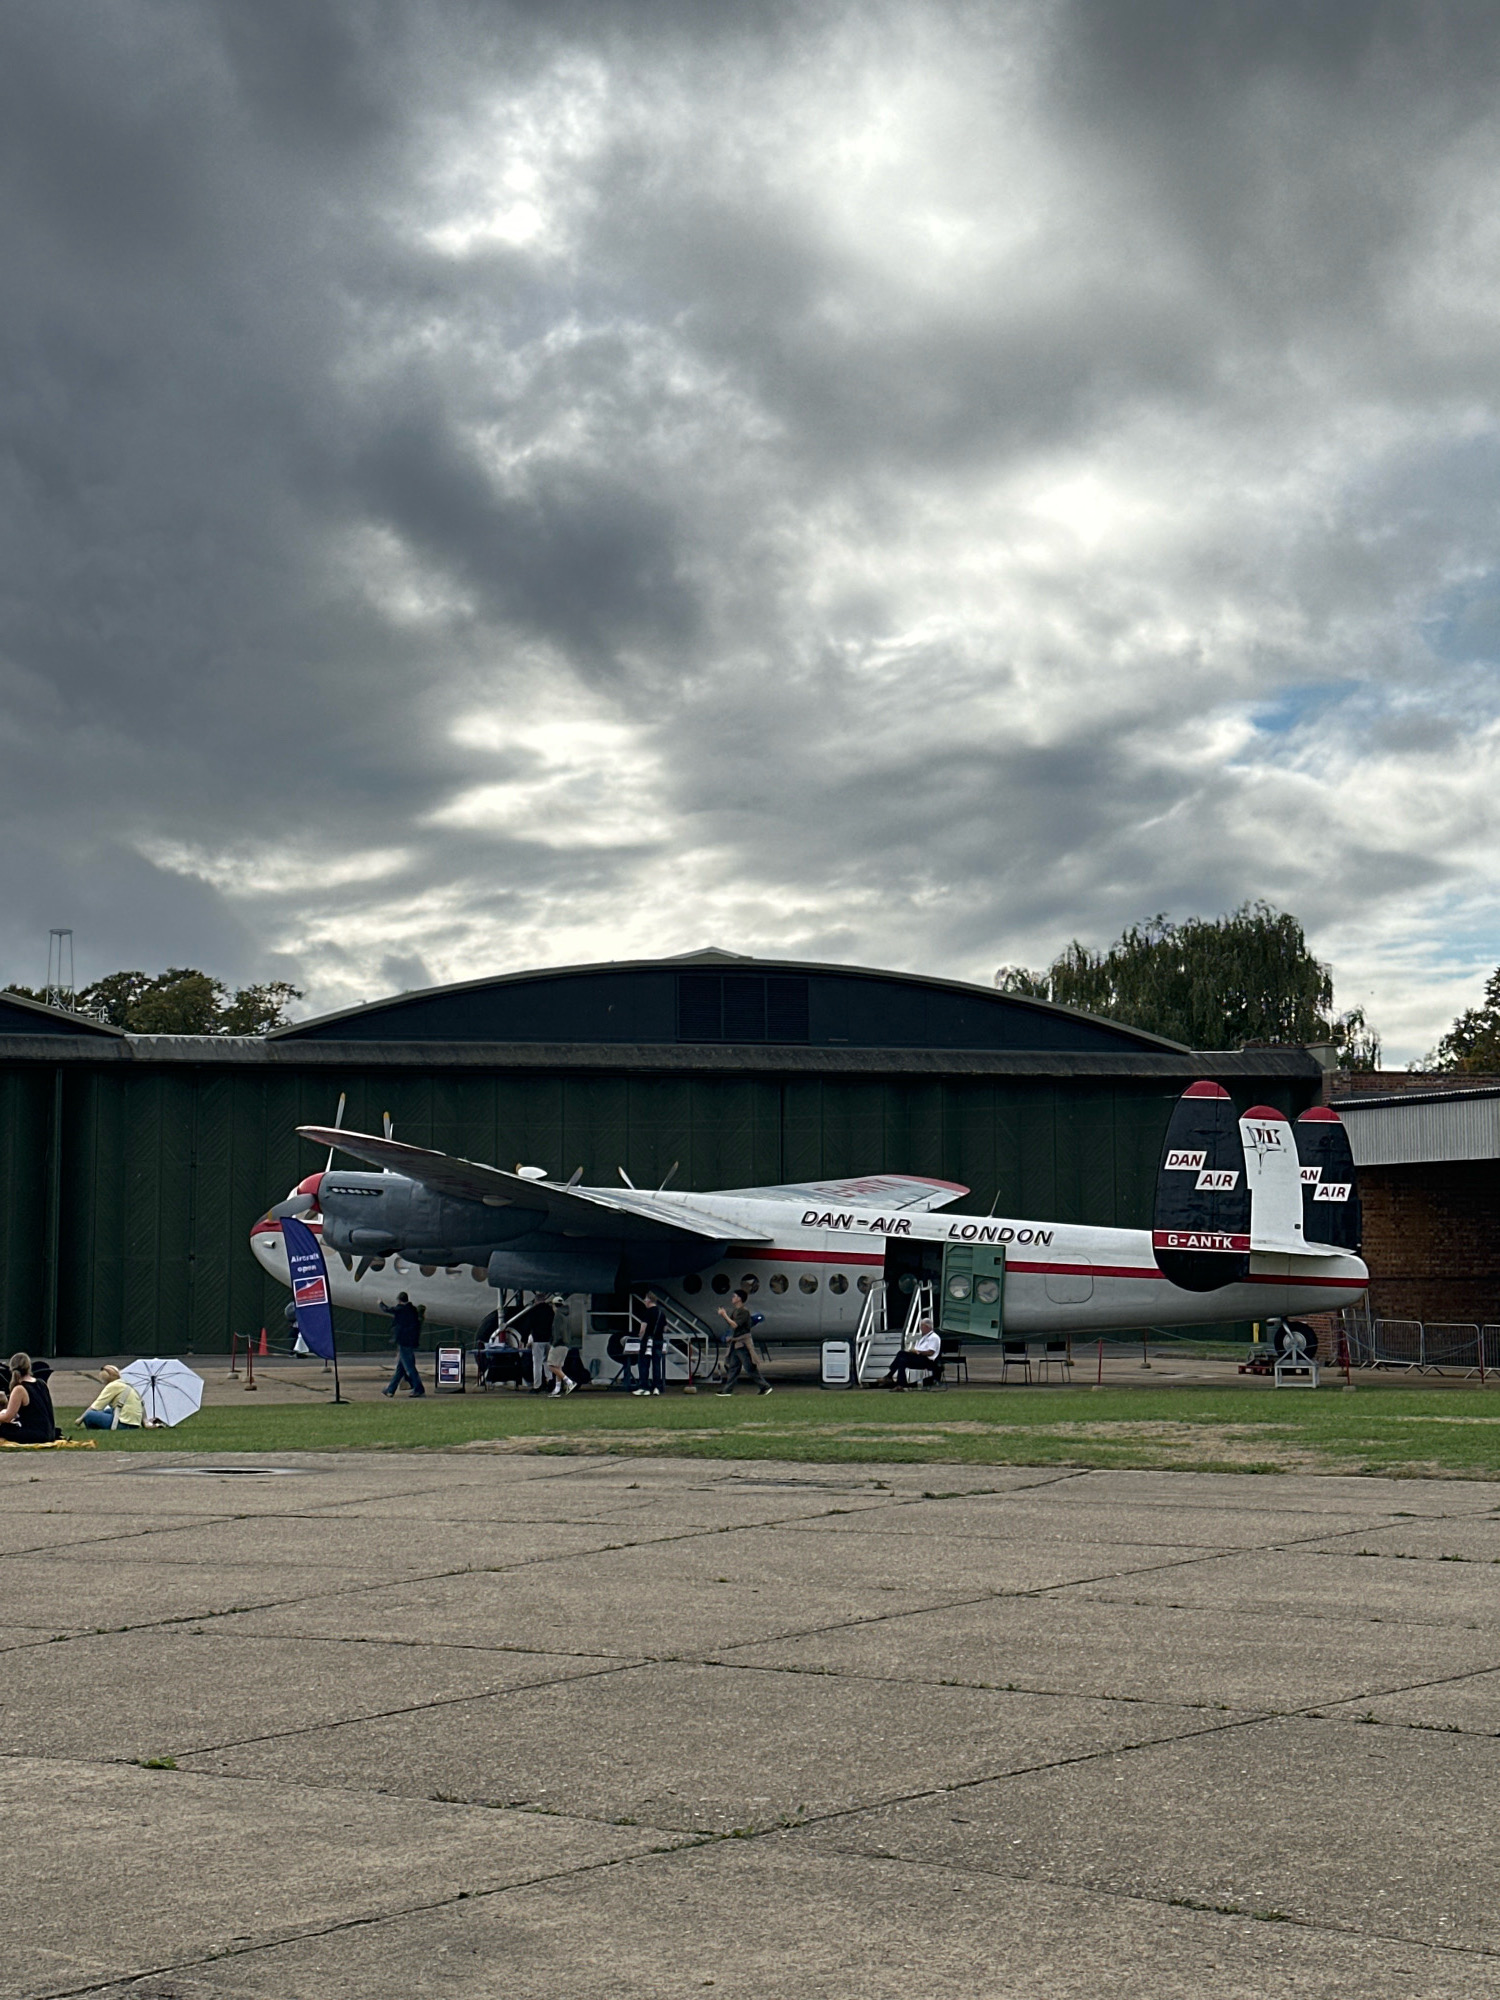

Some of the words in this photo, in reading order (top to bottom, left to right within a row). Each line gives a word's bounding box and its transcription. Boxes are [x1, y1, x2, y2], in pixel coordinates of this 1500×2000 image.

[1168, 1153, 1203, 1167] DAN
[1200, 1174, 1233, 1187] AIR
[1300, 1169, 1319, 1181] AN
[1318, 1186, 1346, 1198] AIR
[801, 1210, 912, 1235] DAN-AIR
[948, 1223, 1054, 1247] LONDON
[1168, 1234, 1233, 1249] G-ANTK
[290, 1252, 320, 1263] Aircraft
[297, 1264, 317, 1273] open
